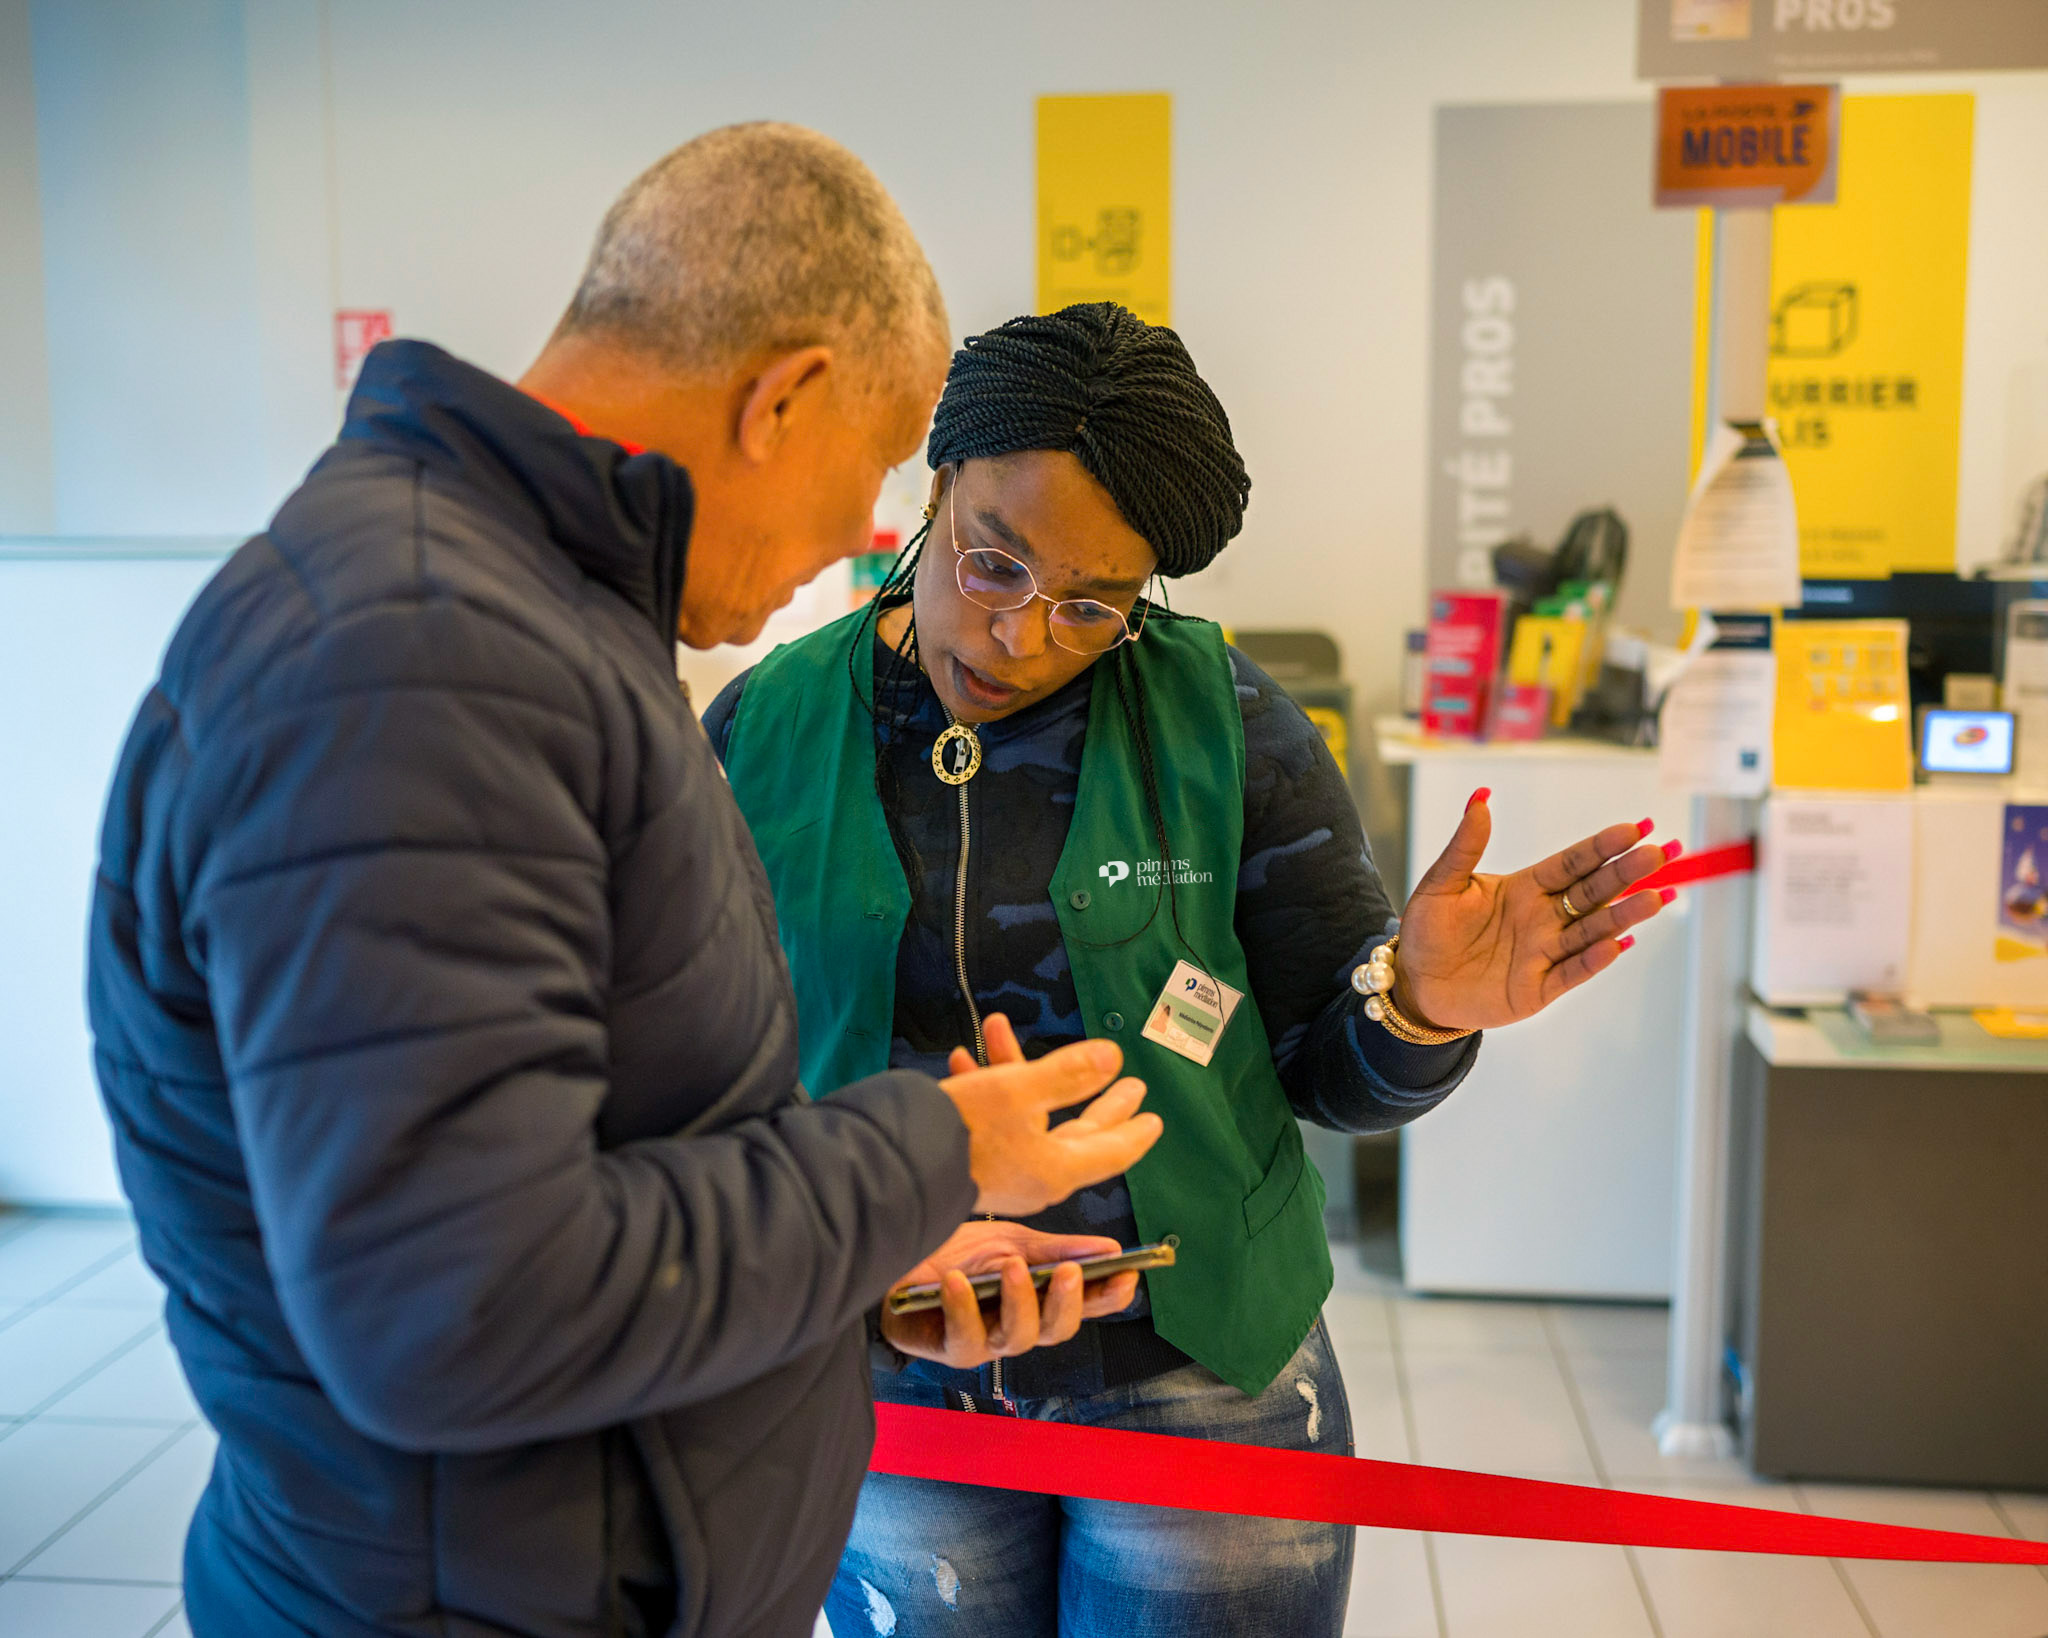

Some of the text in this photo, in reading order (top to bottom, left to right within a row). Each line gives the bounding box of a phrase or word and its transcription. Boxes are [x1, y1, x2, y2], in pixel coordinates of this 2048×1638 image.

[1772, 0, 1896, 32] PROS
[1680, 124, 1811, 168] MOBILE
[1461, 277, 1514, 437] PROS
[1136, 859, 1190, 876] pimms
[1137, 870, 1213, 887] médiation
